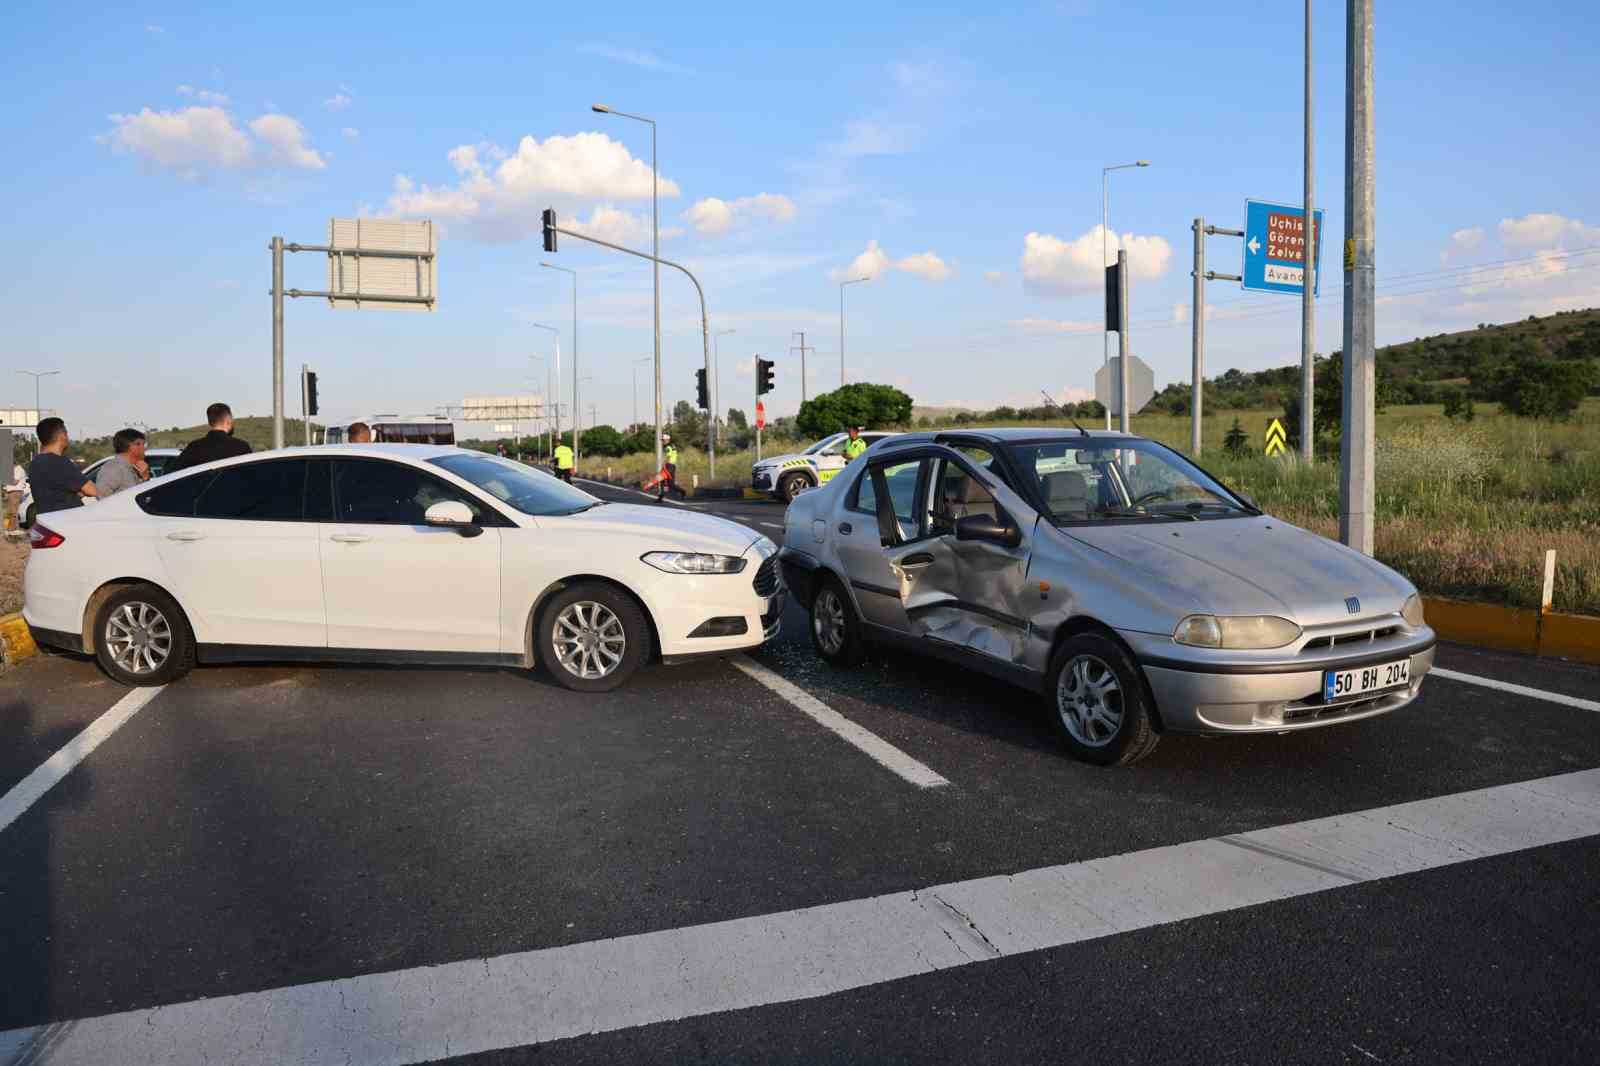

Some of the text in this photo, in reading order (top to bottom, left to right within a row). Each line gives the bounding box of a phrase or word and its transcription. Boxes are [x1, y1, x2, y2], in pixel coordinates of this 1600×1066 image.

[1335, 674, 1352, 693] 50
[1361, 668, 1377, 689] BH
[1386, 664, 1406, 684] 204
